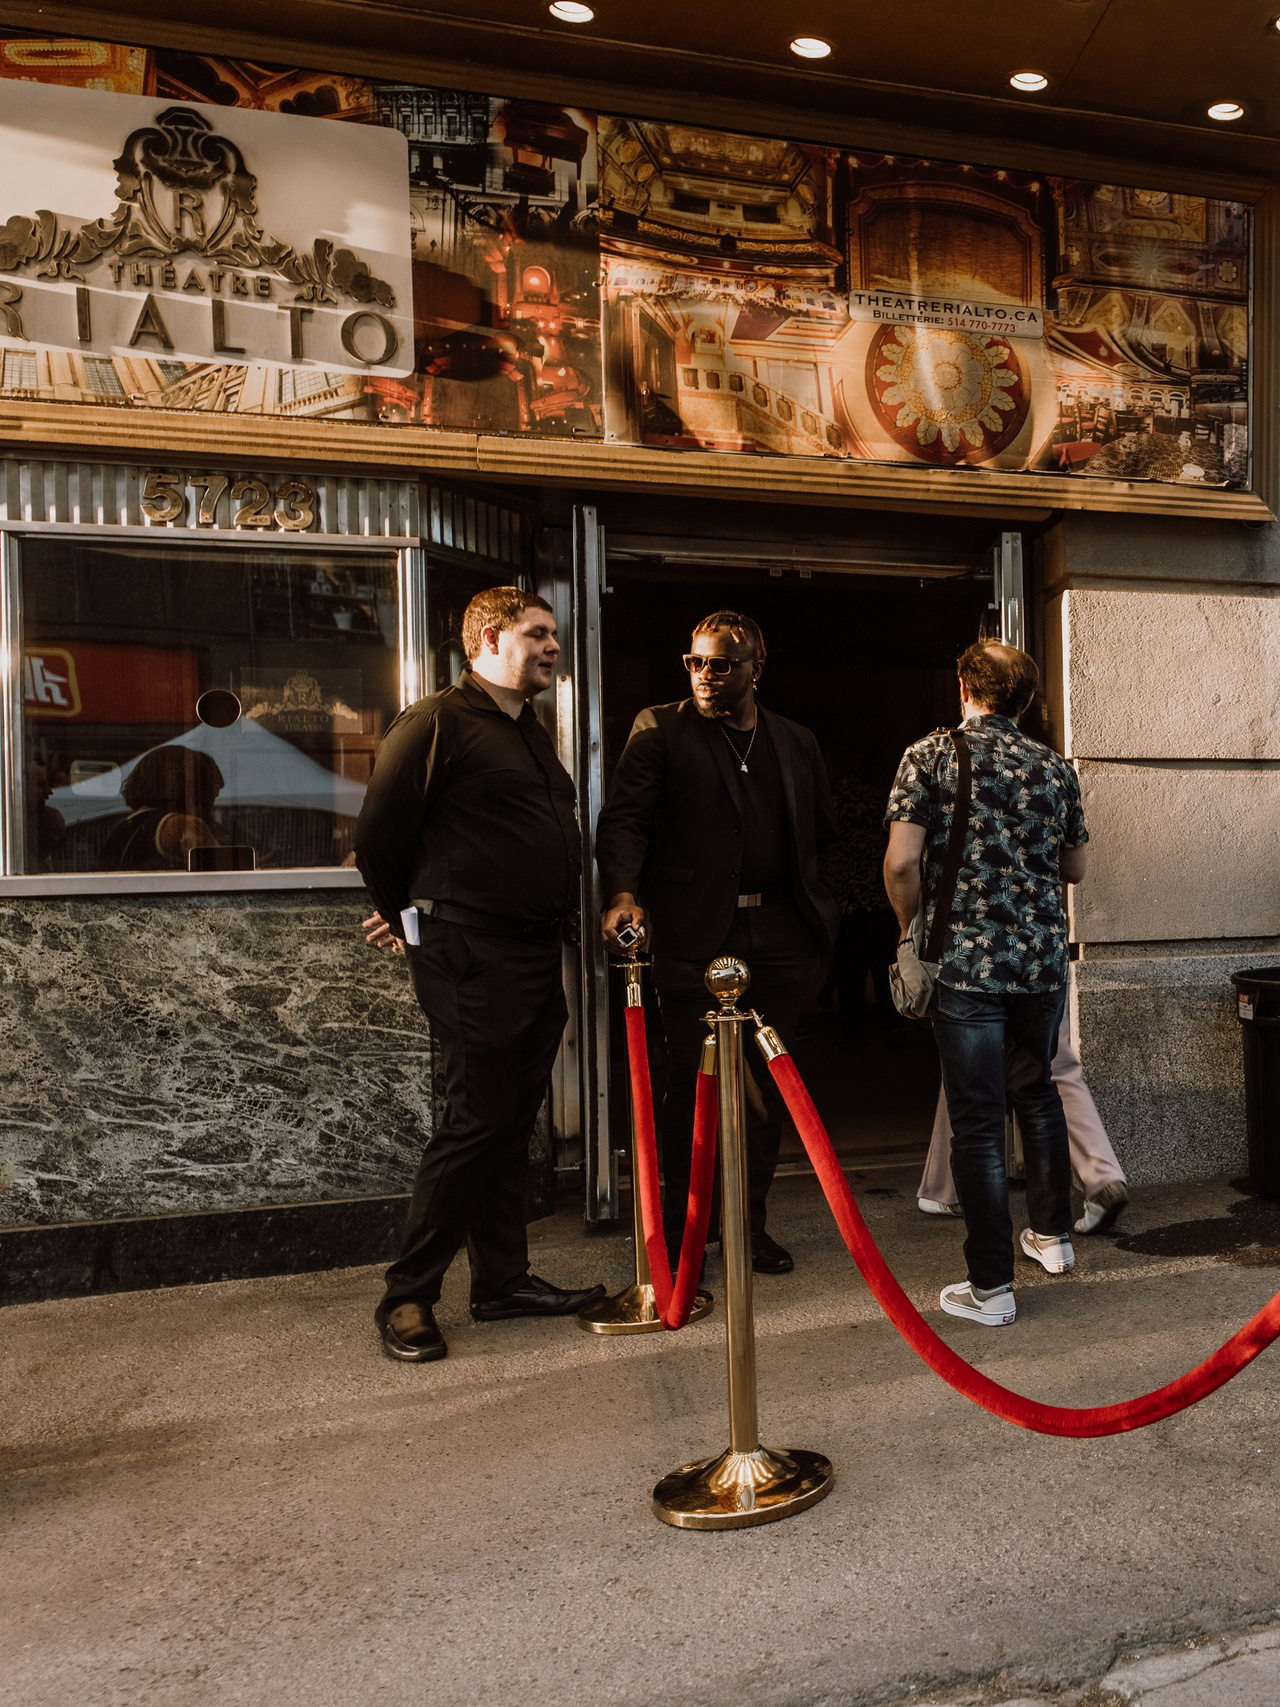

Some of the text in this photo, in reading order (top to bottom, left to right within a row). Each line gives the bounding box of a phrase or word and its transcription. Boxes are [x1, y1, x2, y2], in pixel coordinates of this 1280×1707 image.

[173, 189, 205, 236] R
[109, 260, 271, 297] THÉATRE
[0, 280, 399, 365] RIALTO
[854, 293, 1038, 322] THEATRERIALTO.CA
[947, 317, 966, 327] 514
[969, 319, 1016, 333] 770-7773
[140, 472, 314, 530] 5723
[298, 693, 308, 704] R
[278, 714, 329, 723] RIALTO
